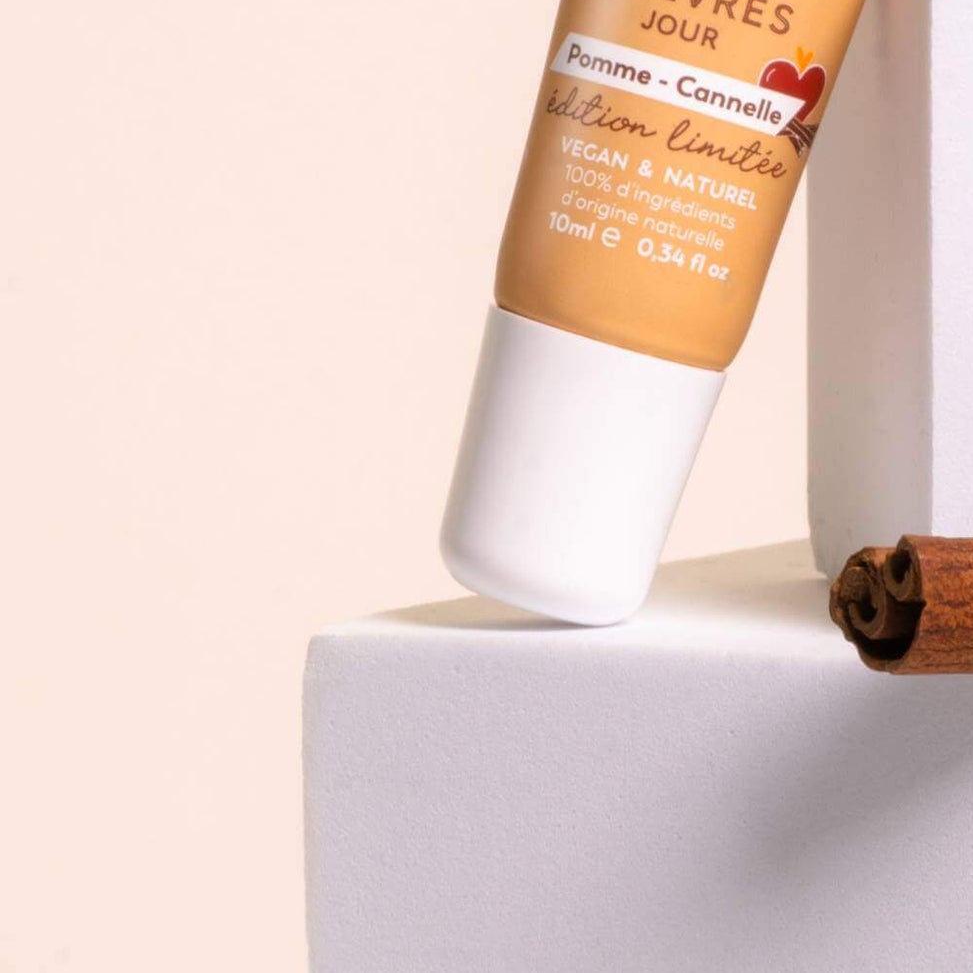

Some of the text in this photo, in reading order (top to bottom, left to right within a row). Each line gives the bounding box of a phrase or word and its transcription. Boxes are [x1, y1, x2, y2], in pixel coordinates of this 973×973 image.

[640, 10, 719, 50] JOUR
[567, 43, 652, 85] Pomme
[676, 76, 782, 125] Cannelle
[547, 87, 787, 178] édition limitée
[561, 136, 757, 210] VEGAN & NATUREL
[565, 163, 737, 230] 100% d'ingrédients
[549, 211, 595, 241] 10ml
[637, 238, 685, 268] 0,34
[690, 254, 705, 273] fl
[707, 264, 730, 280] oz
[561, 190, 725, 252] d'origine naturelle
